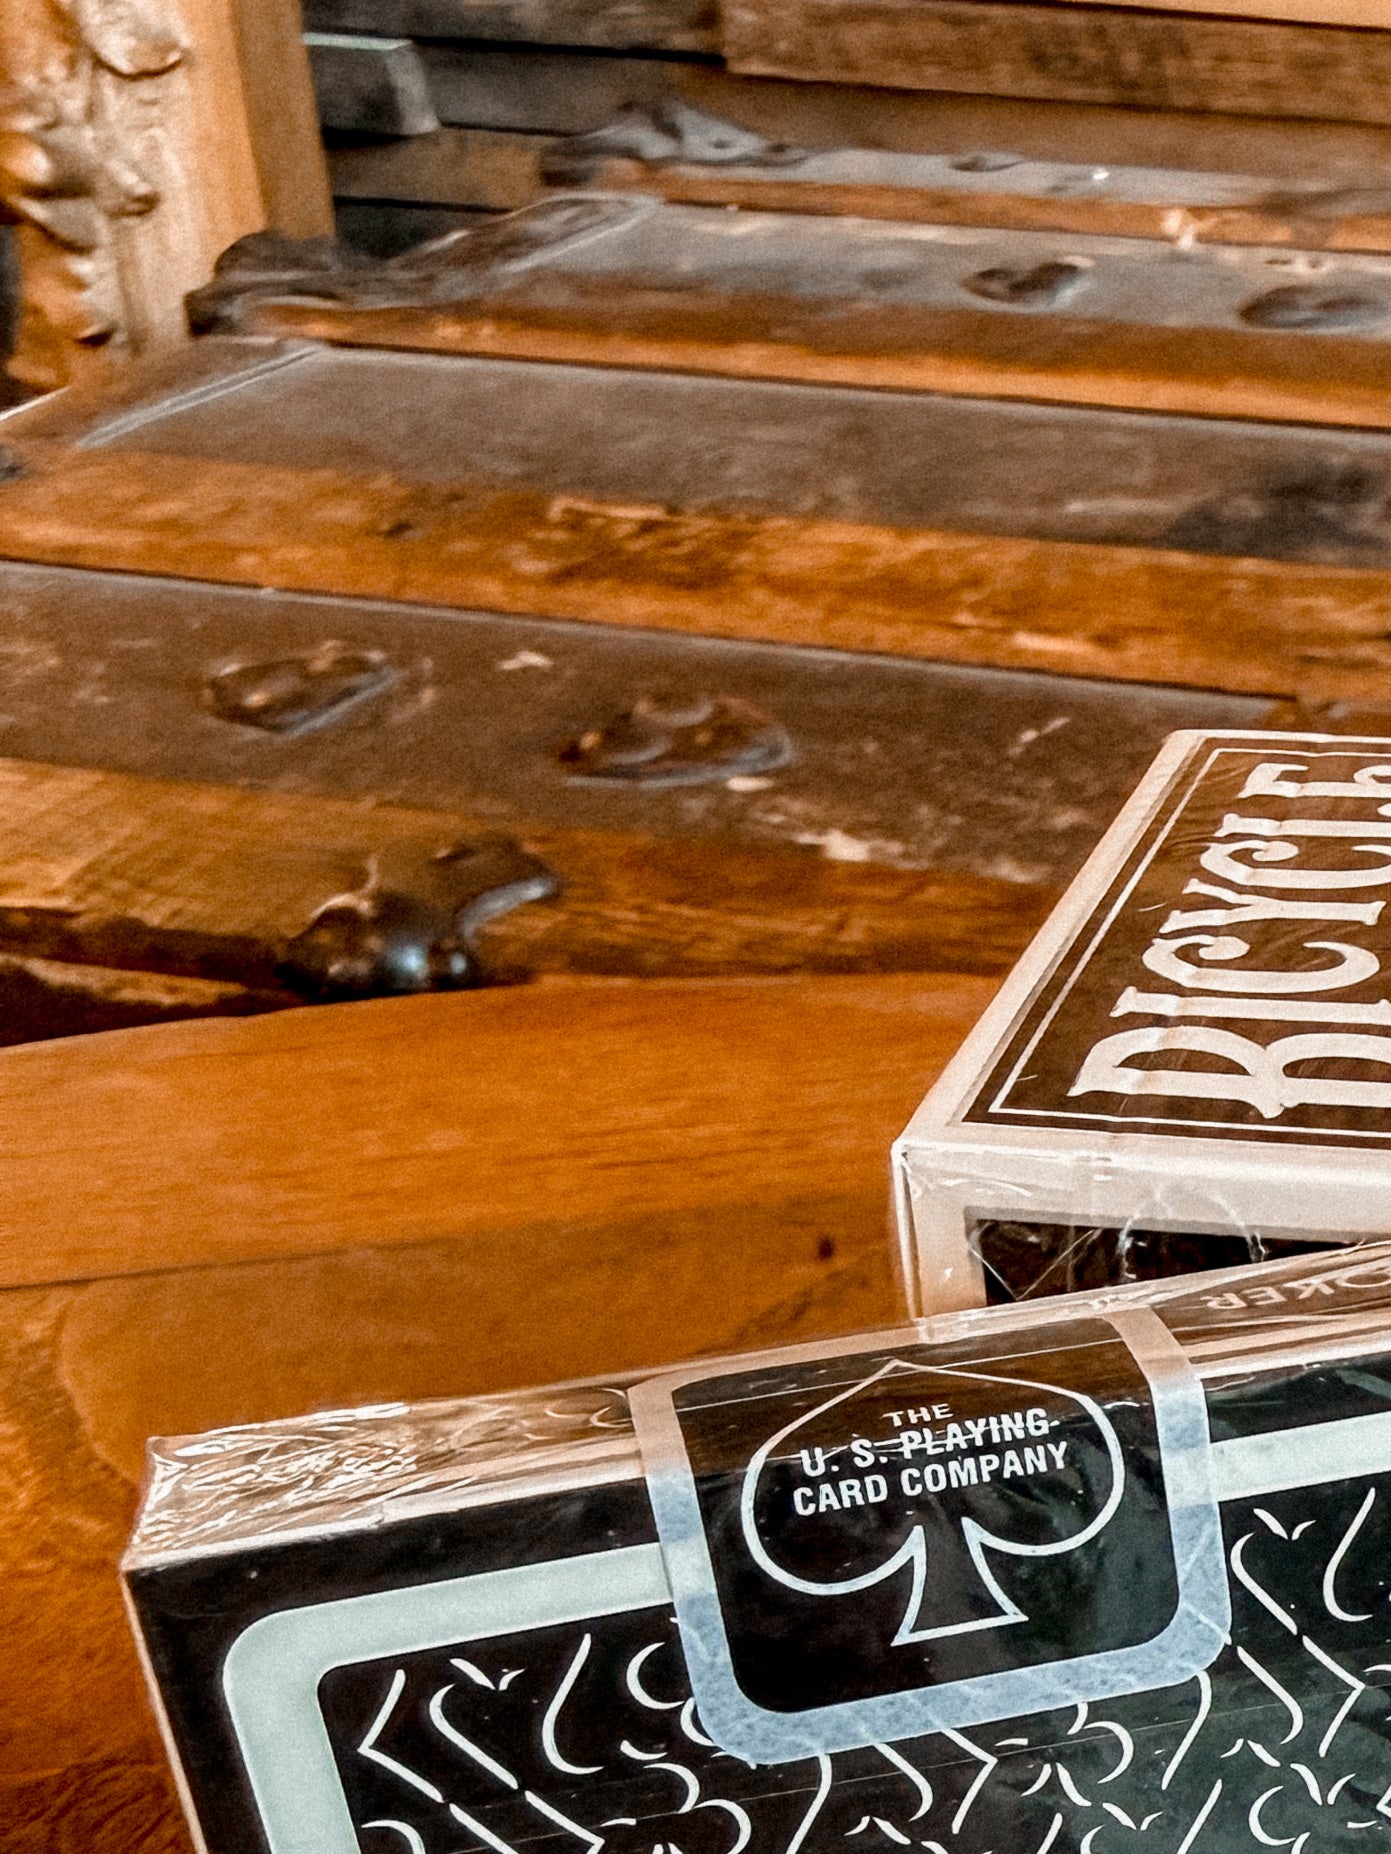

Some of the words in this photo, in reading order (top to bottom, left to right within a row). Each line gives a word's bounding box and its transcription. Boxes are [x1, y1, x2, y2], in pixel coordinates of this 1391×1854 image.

[882, 1403, 954, 1428] THE
[899, 1407, 1049, 1460] PLAYING
[793, 1474, 889, 1517] CARD
[901, 1440, 1068, 1497] COMPANY
